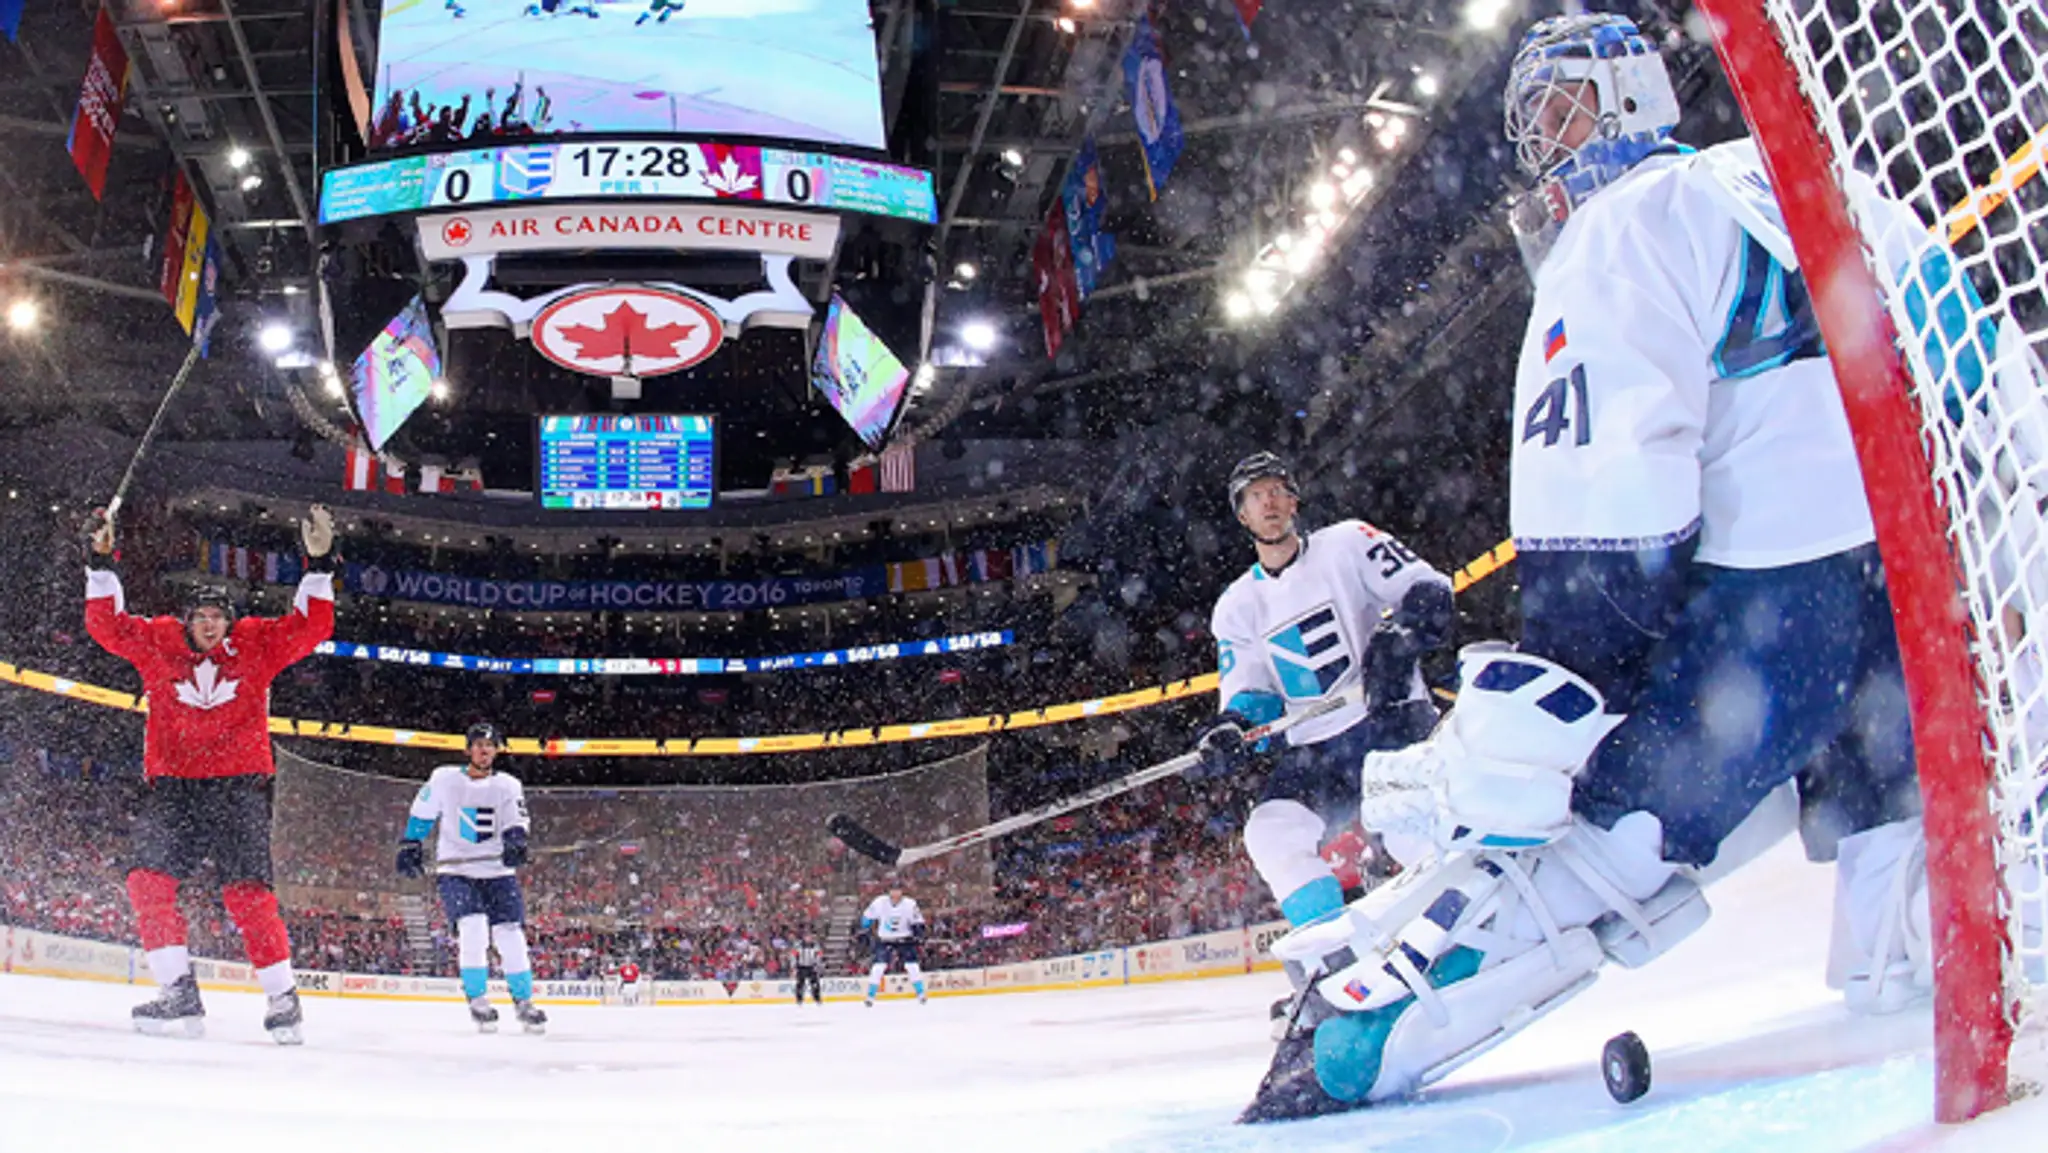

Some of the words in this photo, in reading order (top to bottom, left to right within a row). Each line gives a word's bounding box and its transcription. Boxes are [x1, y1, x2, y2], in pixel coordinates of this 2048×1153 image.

[573, 146, 690, 177] 17:28
[445, 169, 471, 202] 0
[600, 180, 642, 193] PER
[787, 168, 811, 202] 0
[489, 217, 540, 237] AIR
[554, 215, 684, 235] CANADA
[696, 215, 813, 242] CENTRE
[1712, 226, 1827, 380] 4
[1522, 362, 1591, 448] 41
[394, 570, 500, 605] WORLD
[506, 583, 565, 605] CUP
[590, 583, 715, 606] HOCKEY
[721, 583, 786, 605] 2016
[792, 575, 865, 595] TORONTO
[222, 637, 239, 656] C
[847, 643, 900, 663] 50/50
[947, 631, 1002, 650] 50/50
[377, 645, 431, 665] 50/50
[546, 982, 604, 997] SAMSU
